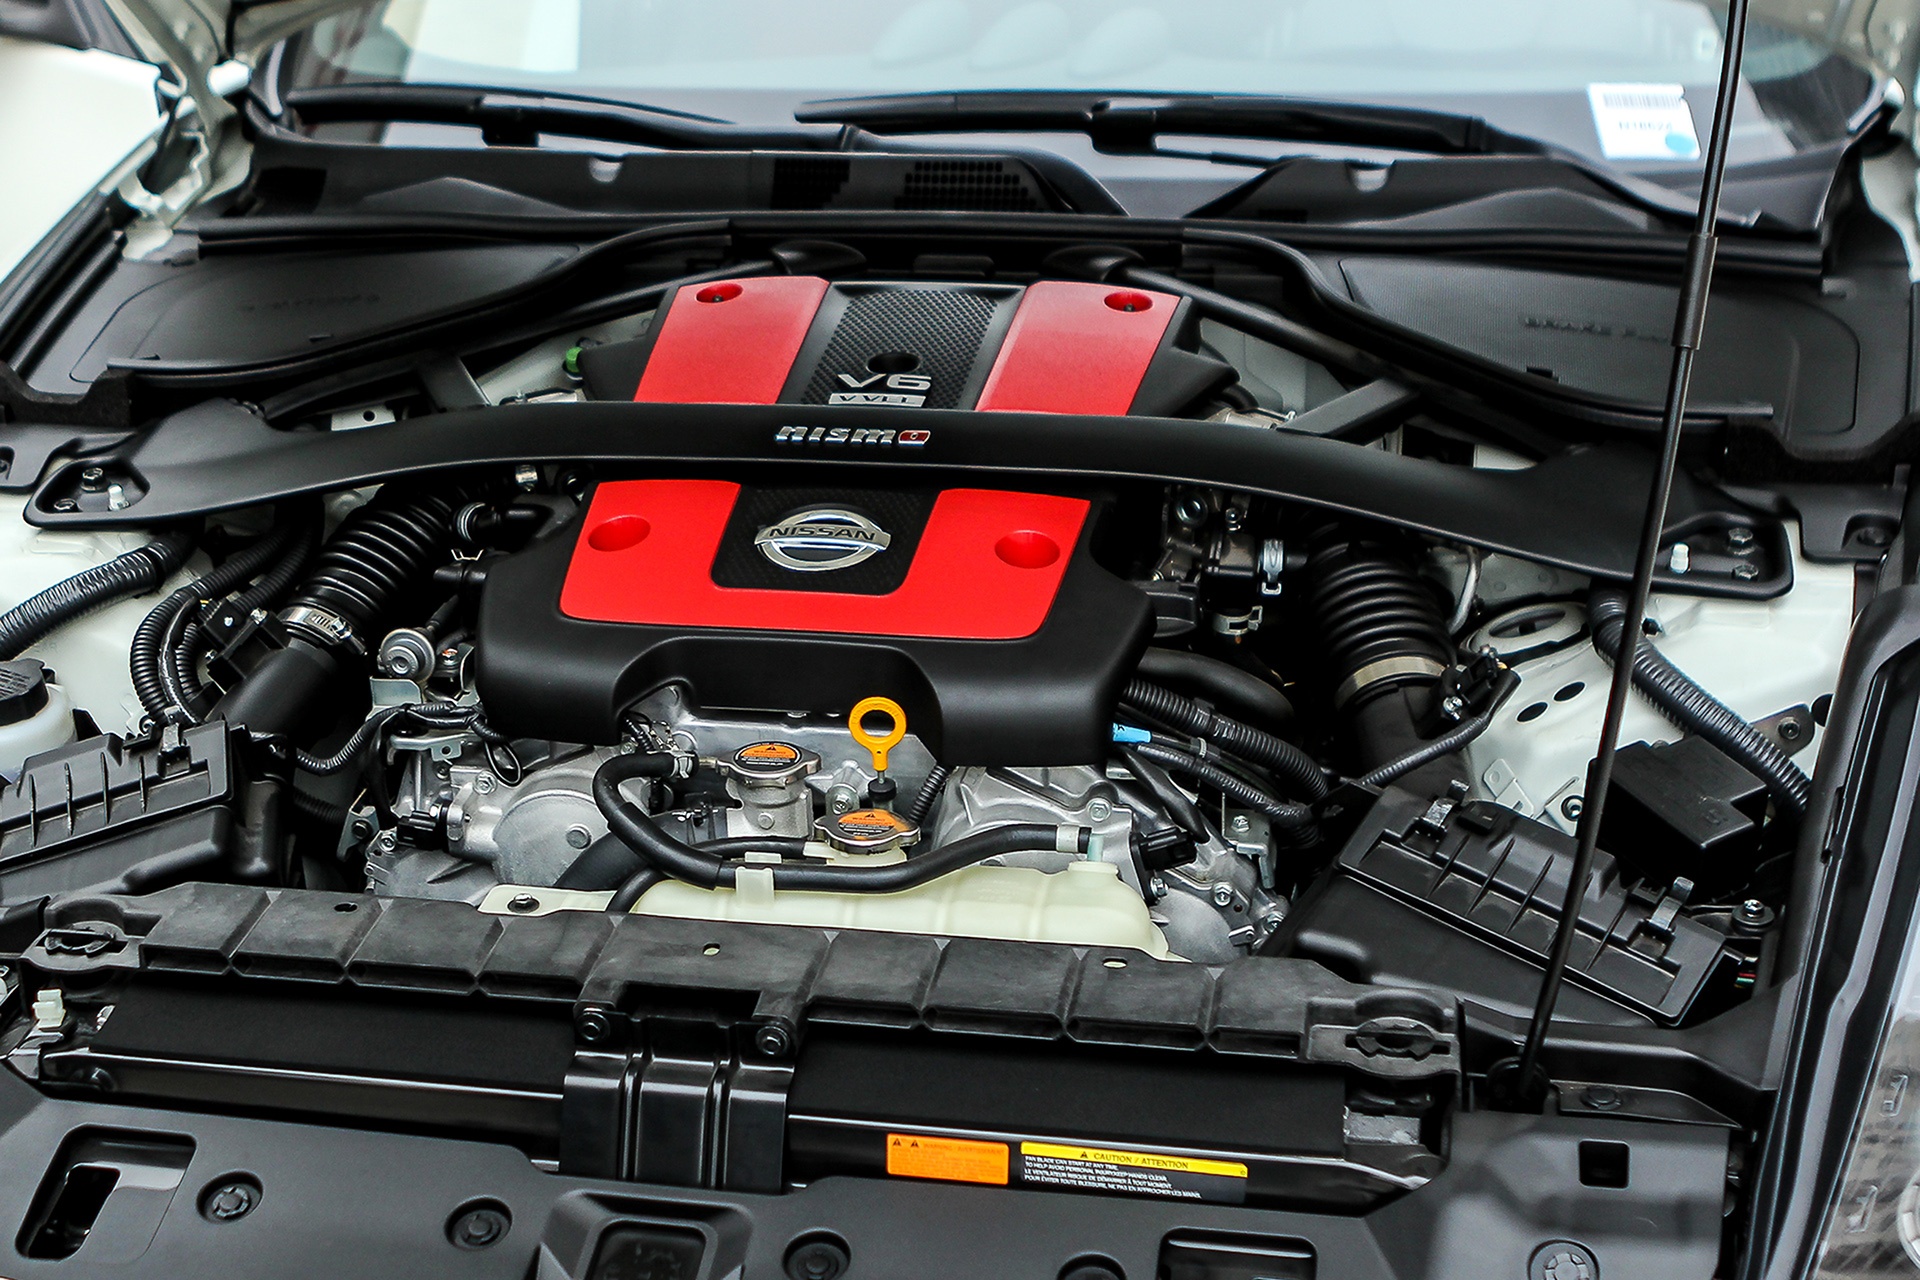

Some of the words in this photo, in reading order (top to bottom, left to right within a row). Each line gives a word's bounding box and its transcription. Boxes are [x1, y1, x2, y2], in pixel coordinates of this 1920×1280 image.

[838, 374, 931, 390] V6
[769, 526, 876, 541] NISSAN
[1094, 1152, 1132, 1163] CAUTION
[1141, 1158, 1188, 1169] ATTENTION
